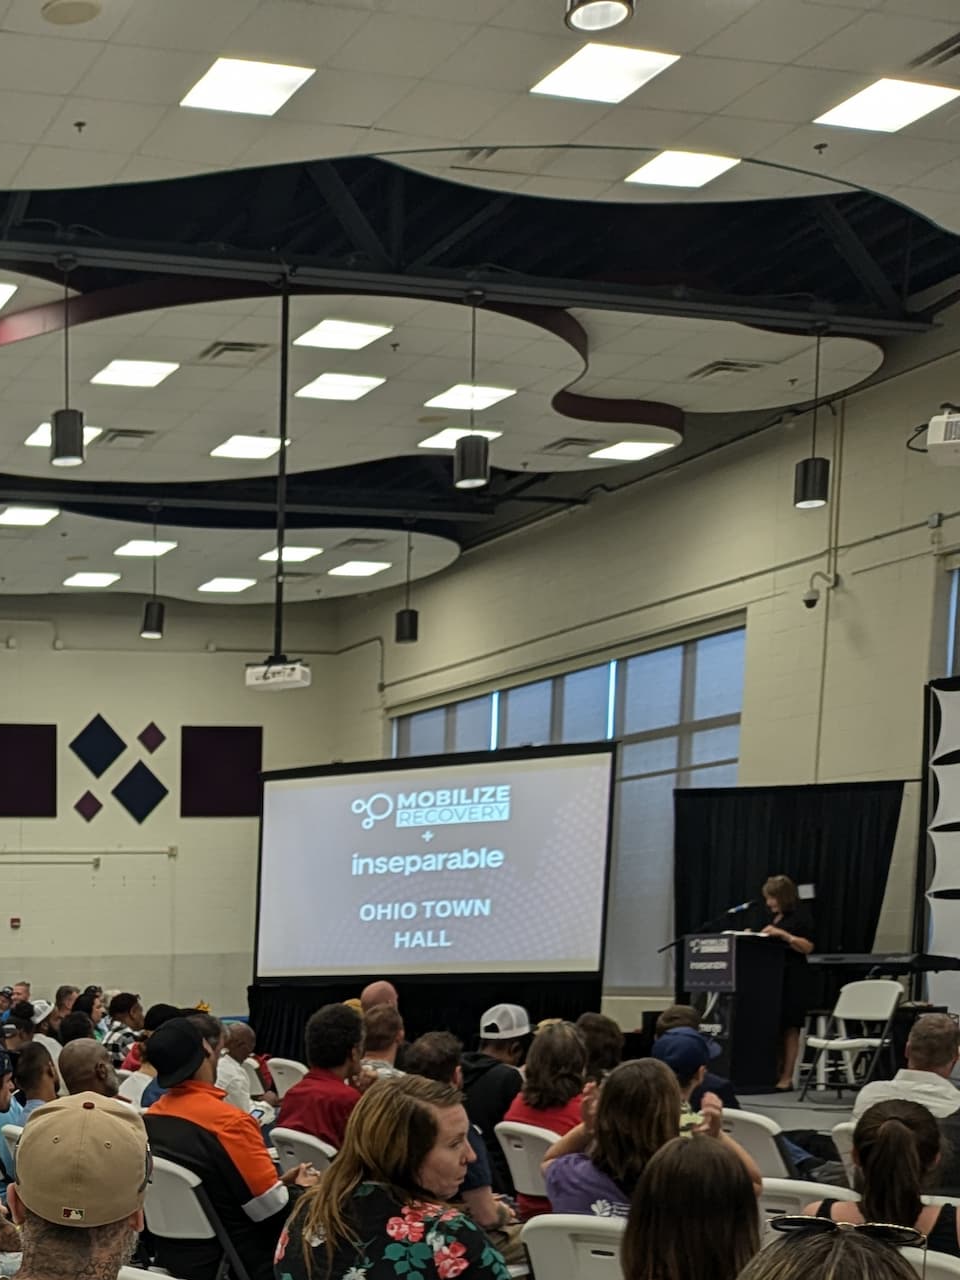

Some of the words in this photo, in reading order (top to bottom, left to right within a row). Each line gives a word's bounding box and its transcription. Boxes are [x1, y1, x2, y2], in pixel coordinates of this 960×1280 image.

[397, 785, 511, 809] MOBILIZE
[398, 804, 508, 826] RECOVERY
[352, 847, 504, 876] inseparable
[359, 902, 417, 922] OHIO
[421, 899, 492, 919] TOWN
[393, 930, 452, 949] HALL
